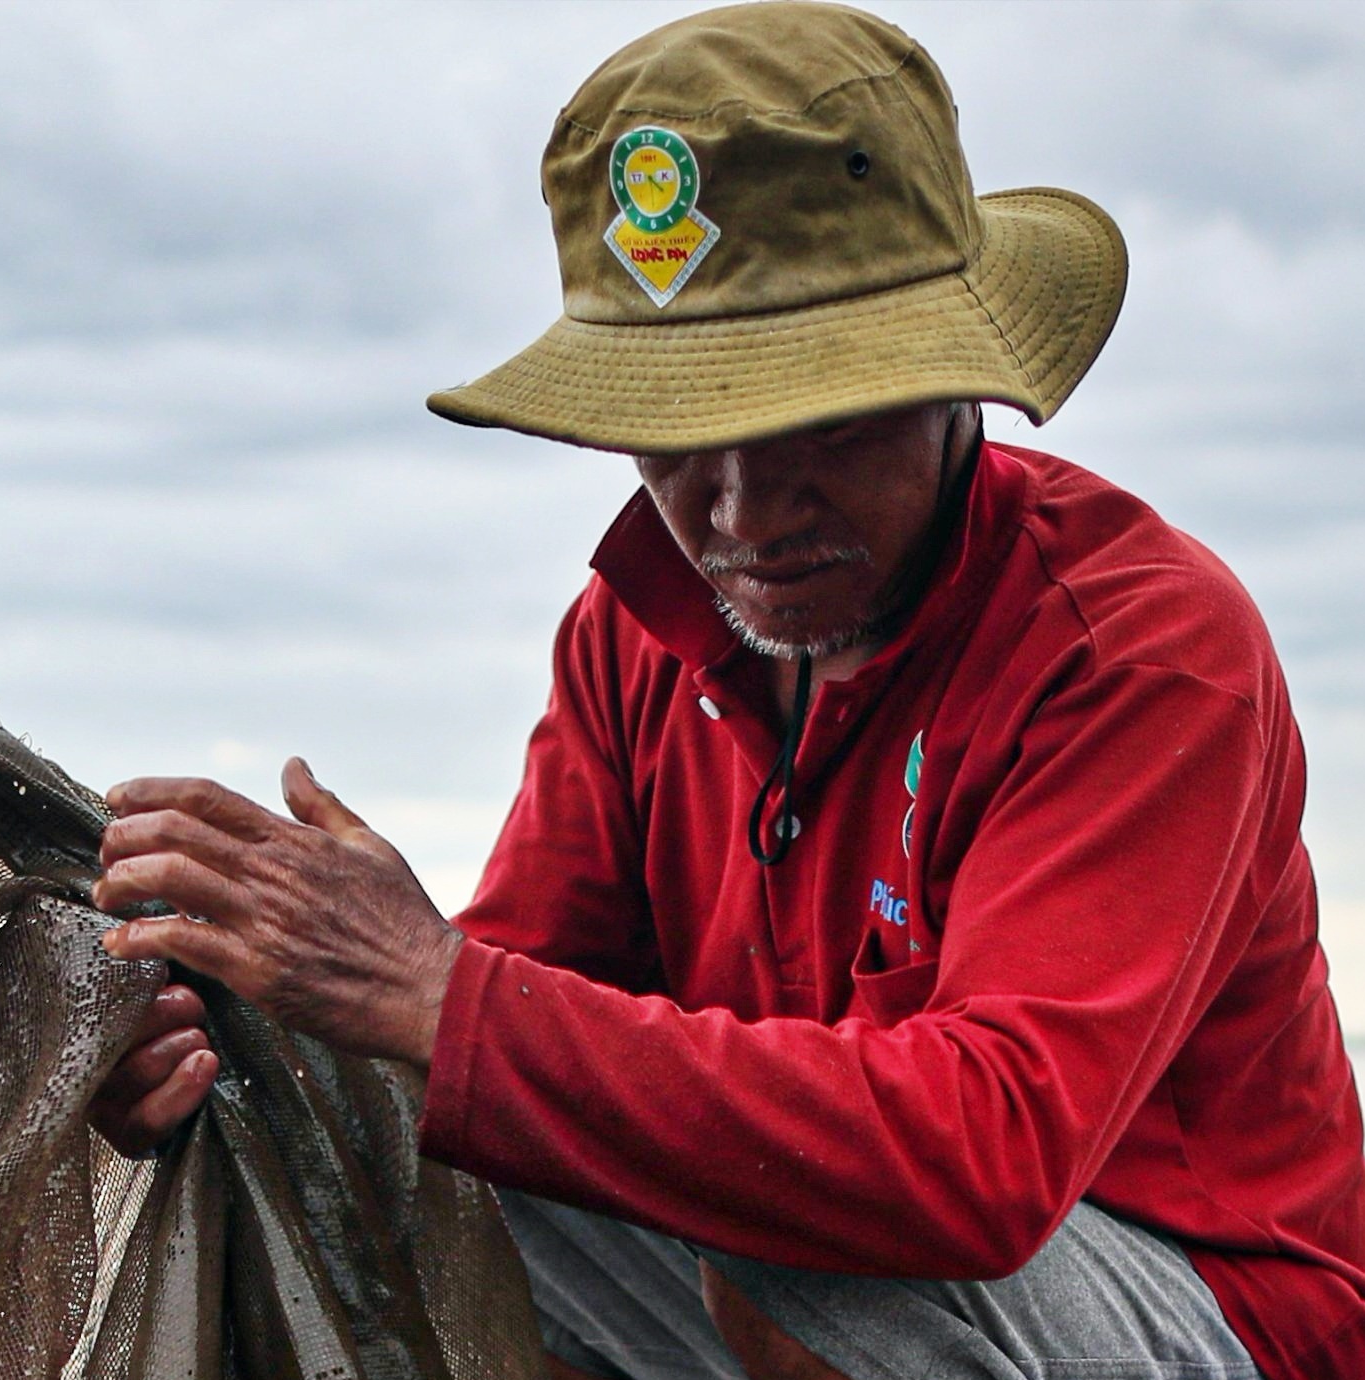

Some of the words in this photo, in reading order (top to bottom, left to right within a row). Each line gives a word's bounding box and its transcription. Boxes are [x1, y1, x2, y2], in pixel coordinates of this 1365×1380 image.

[640, 133, 654, 144] 12
[616, 180, 624, 190] 9
[683, 176, 691, 186] 3
[650, 219, 657, 230] 6
